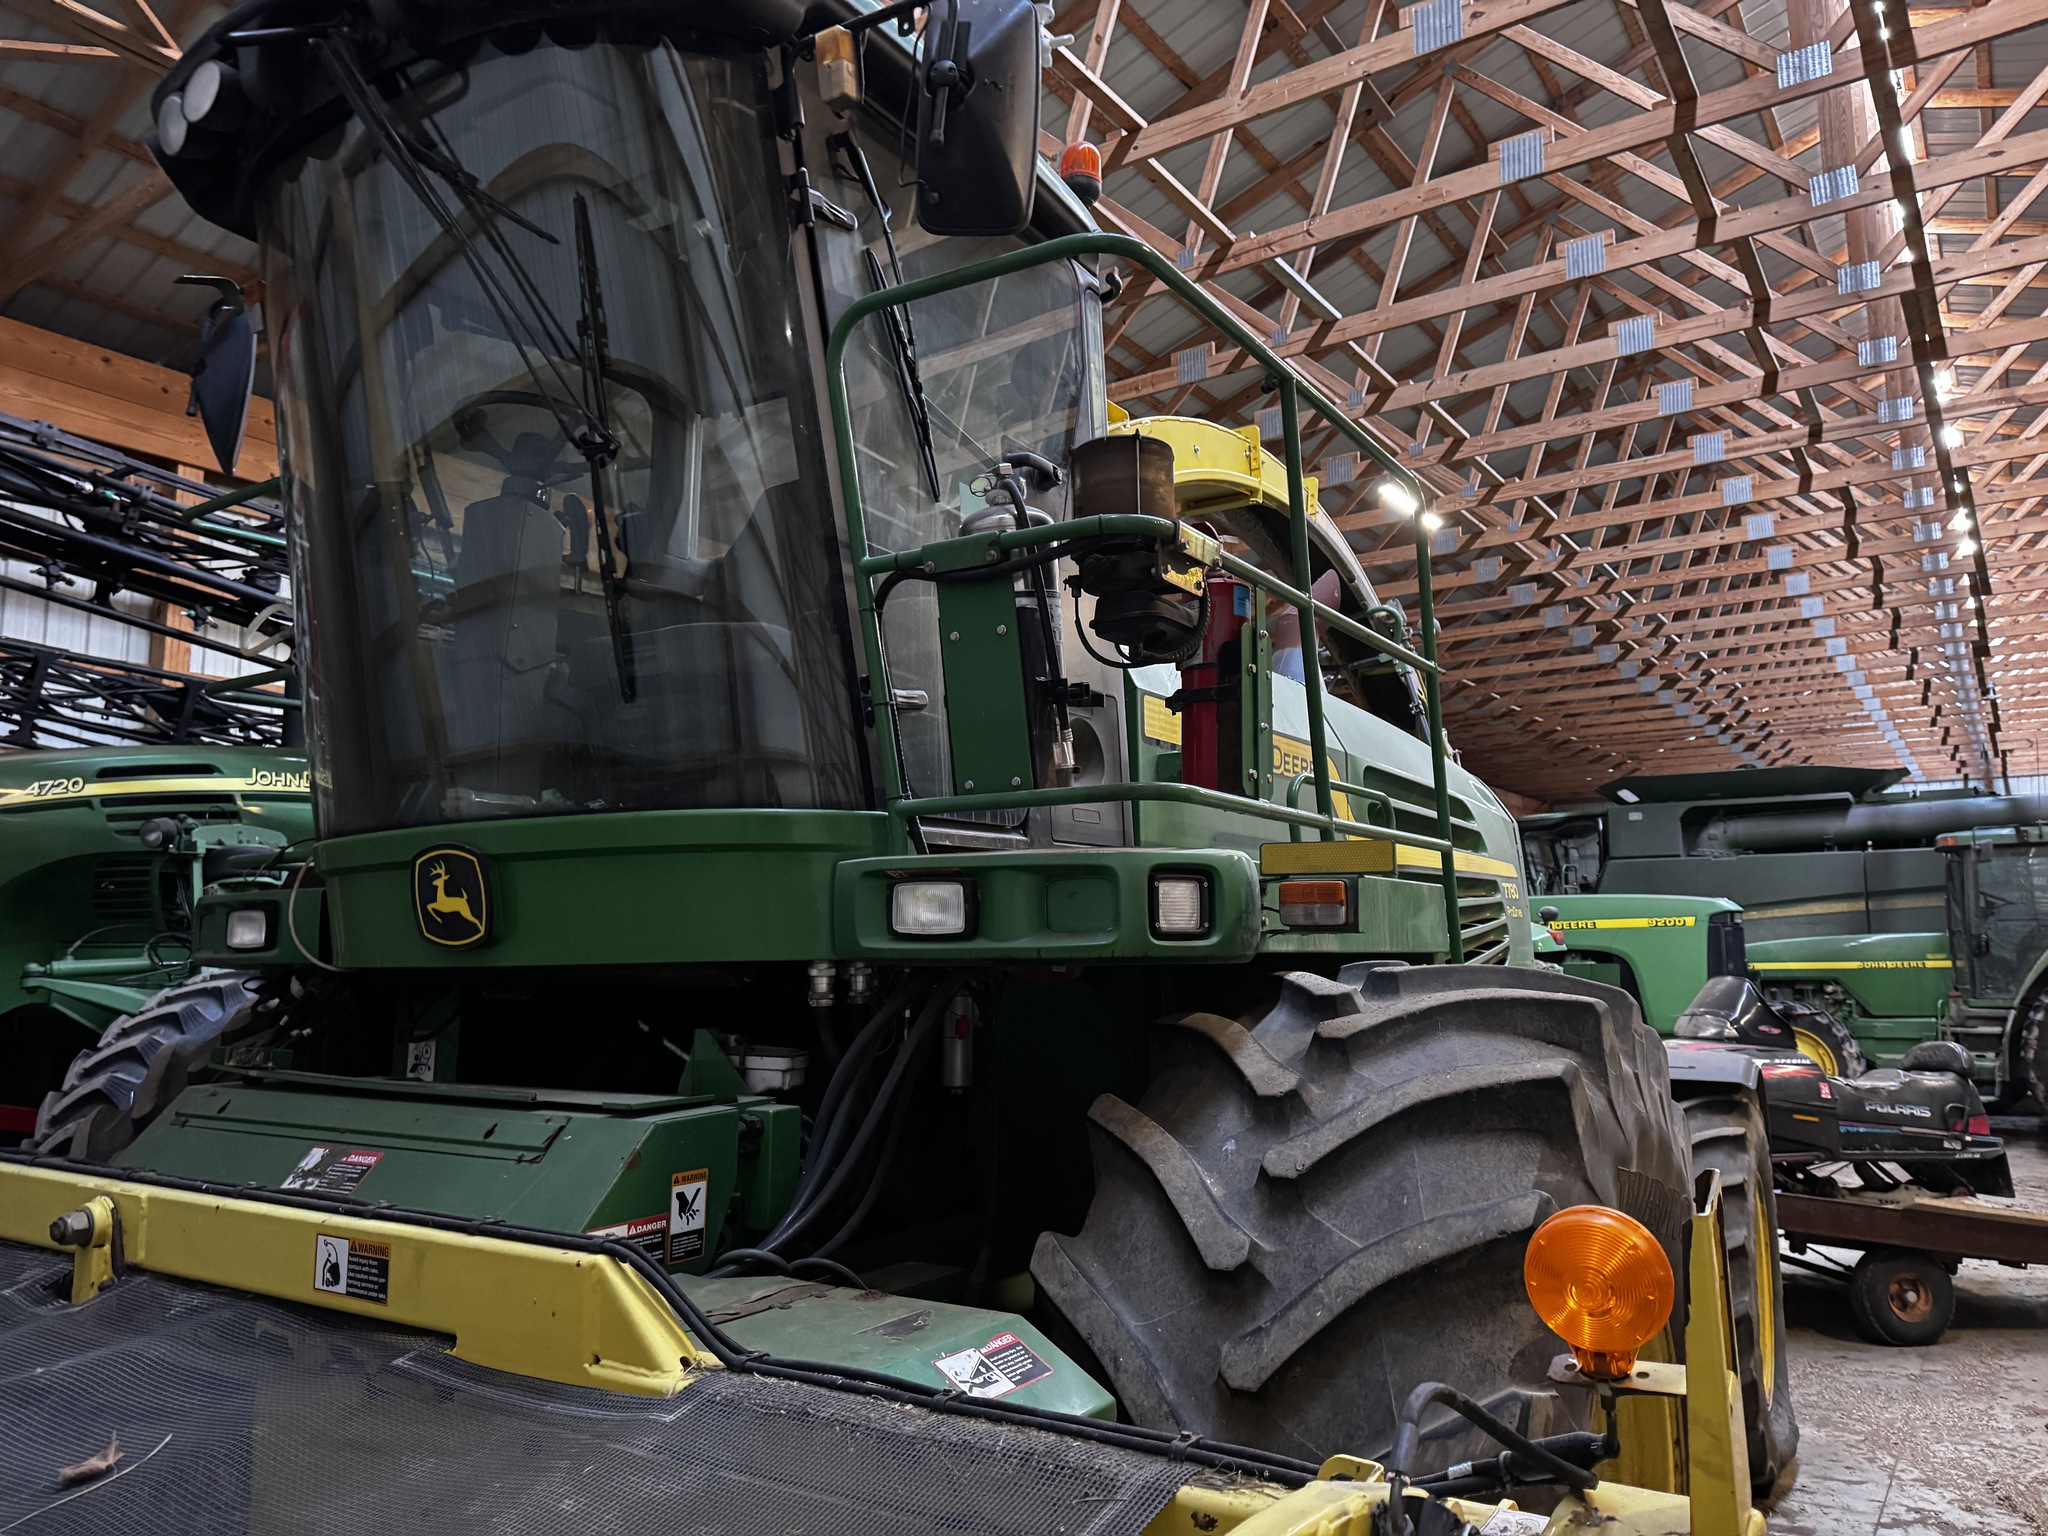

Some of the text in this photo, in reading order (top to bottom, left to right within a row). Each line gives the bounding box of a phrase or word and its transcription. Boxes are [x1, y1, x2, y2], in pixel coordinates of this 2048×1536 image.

[1273, 745, 1314, 775] DEER
[245, 767, 299, 787] JOHN
[24, 777, 84, 797] 4720
[1553, 920, 1595, 930] DEERE
[1648, 918, 1685, 927] 9200
[1864, 1101, 1932, 1118] POLARIS
[347, 1154, 378, 1164] DANGER
[681, 1171, 707, 1183] WARNING
[636, 1220, 667, 1234] DANGER
[358, 1242, 389, 1258] WARNING
[349, 1255, 359, 1263] Avoid
